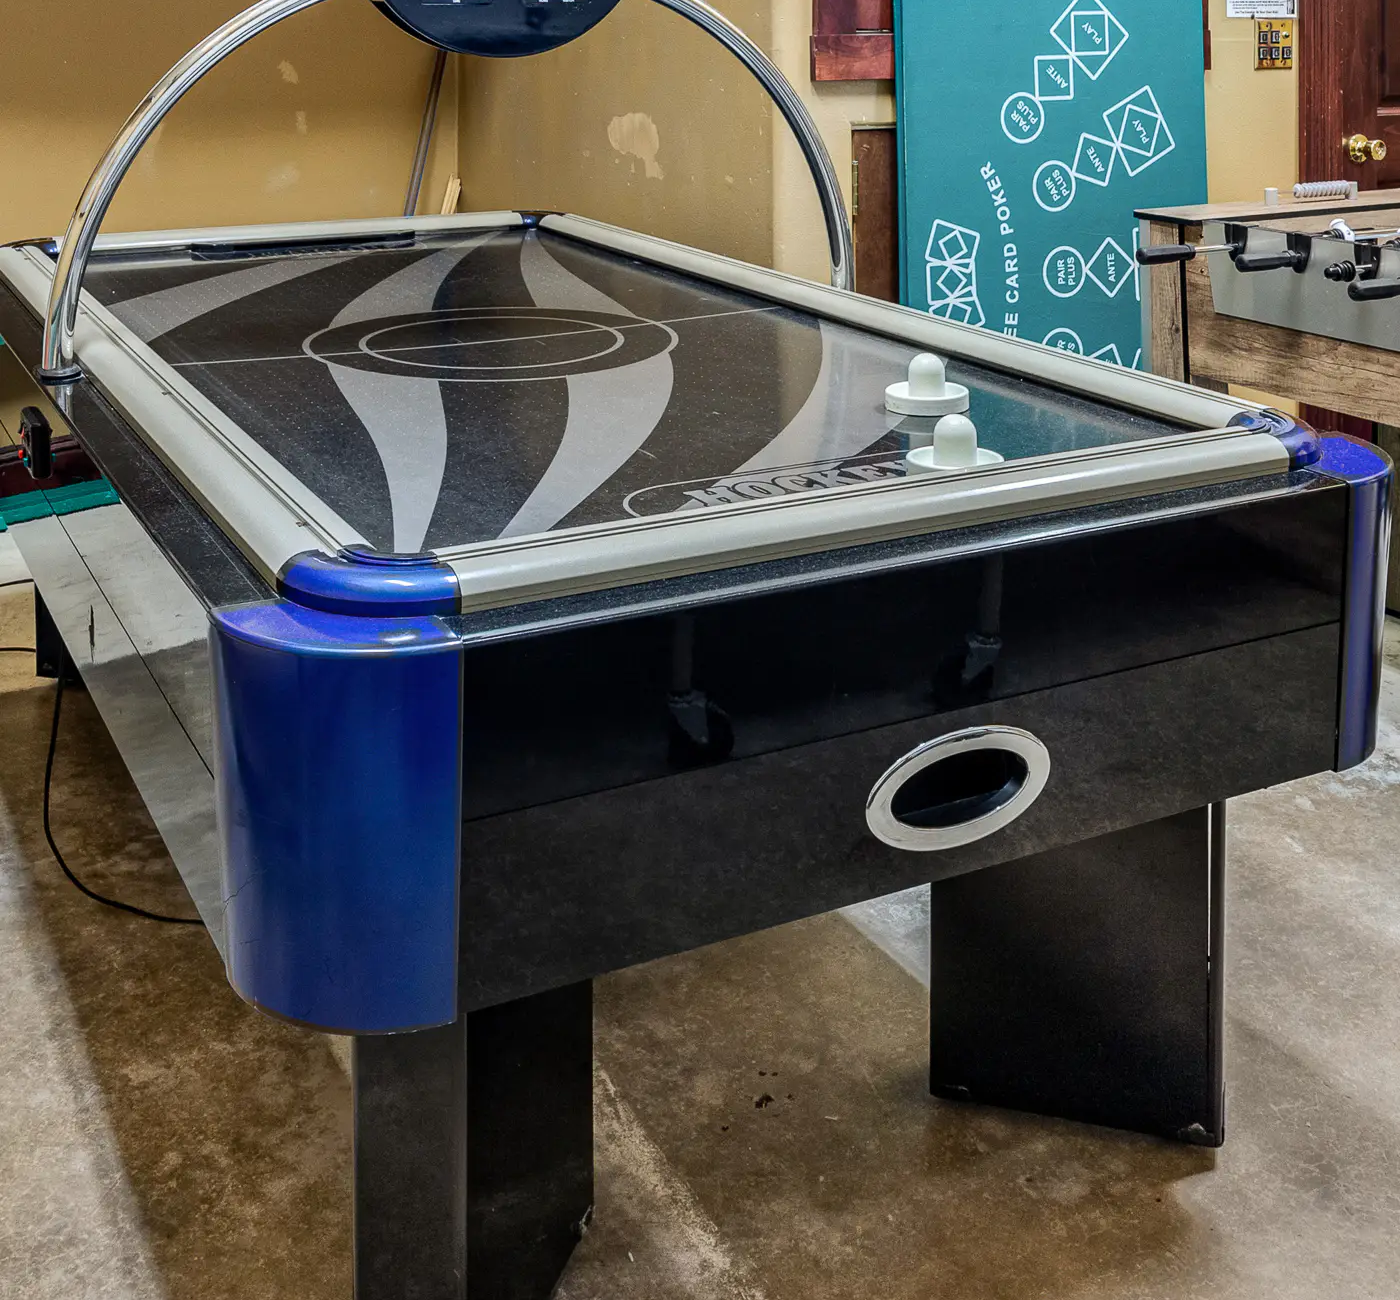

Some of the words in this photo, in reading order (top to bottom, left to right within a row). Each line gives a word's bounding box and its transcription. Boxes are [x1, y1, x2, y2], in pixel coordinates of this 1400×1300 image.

[1081, 22, 1103, 45] PLAY
[1045, 64, 1069, 89] ANTE
[1010, 110, 1031, 133] PAIR
[1016, 100, 1038, 125] PLUS
[1132, 119, 1150, 144] PLAY
[1086, 145, 1105, 173] ANTE
[1044, 176, 1061, 202] PAIR
[1051, 169, 1070, 197] PLUS
[979, 161, 1015, 236] POKER
[1003, 242, 1020, 304] CARD
[1056, 259, 1066, 285] PAIR
[1066, 256, 1076, 286] PLUS
[1106, 252, 1116, 283] ANTE
